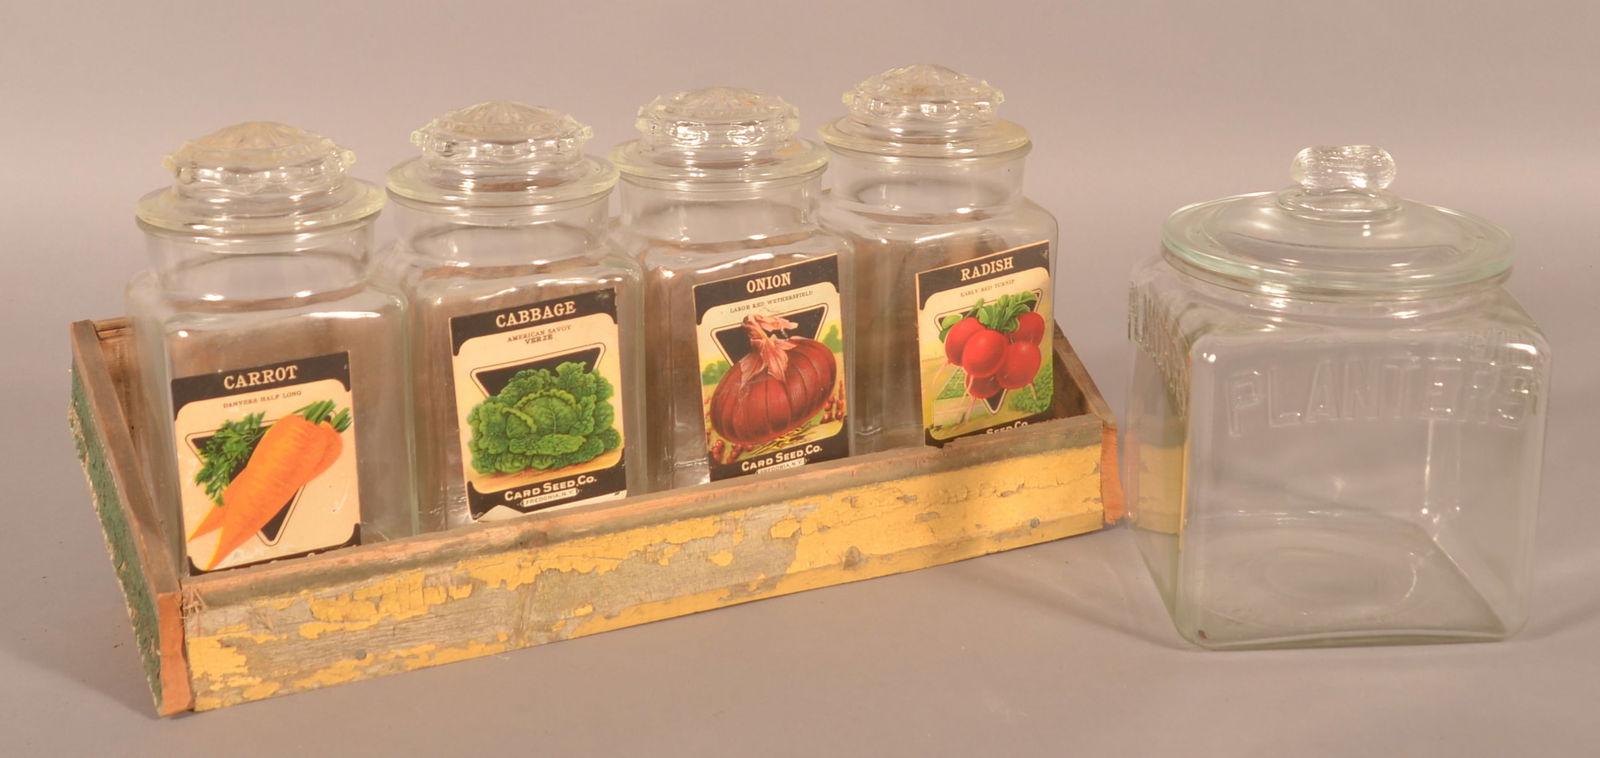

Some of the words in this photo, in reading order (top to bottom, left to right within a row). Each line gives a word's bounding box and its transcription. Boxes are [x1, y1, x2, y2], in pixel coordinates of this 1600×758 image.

[960, 256, 1014, 282] RADISH
[746, 271, 792, 293] ONION
[960, 288, 978, 297] EARLY
[980, 284, 993, 294] RED
[994, 279, 1015, 289] TURNIP
[730, 304, 750, 313] LARGE
[752, 301, 765, 309] RED
[767, 290, 813, 305] WETHERSFIELD
[495, 300, 577, 328] CABBAGE
[507, 329, 545, 342] AMERICAN
[547, 324, 571, 335] SAVOY
[524, 334, 553, 345] VERZE
[223, 365, 299, 390] CARROT
[223, 397, 258, 409] DANVERS
[260, 393, 280, 404] HALF
[282, 390, 302, 399] LONG
[1226, 355, 1529, 438] PLANTERS
[741, 457, 773, 472] CARD
[504, 487, 541, 501] CARD
